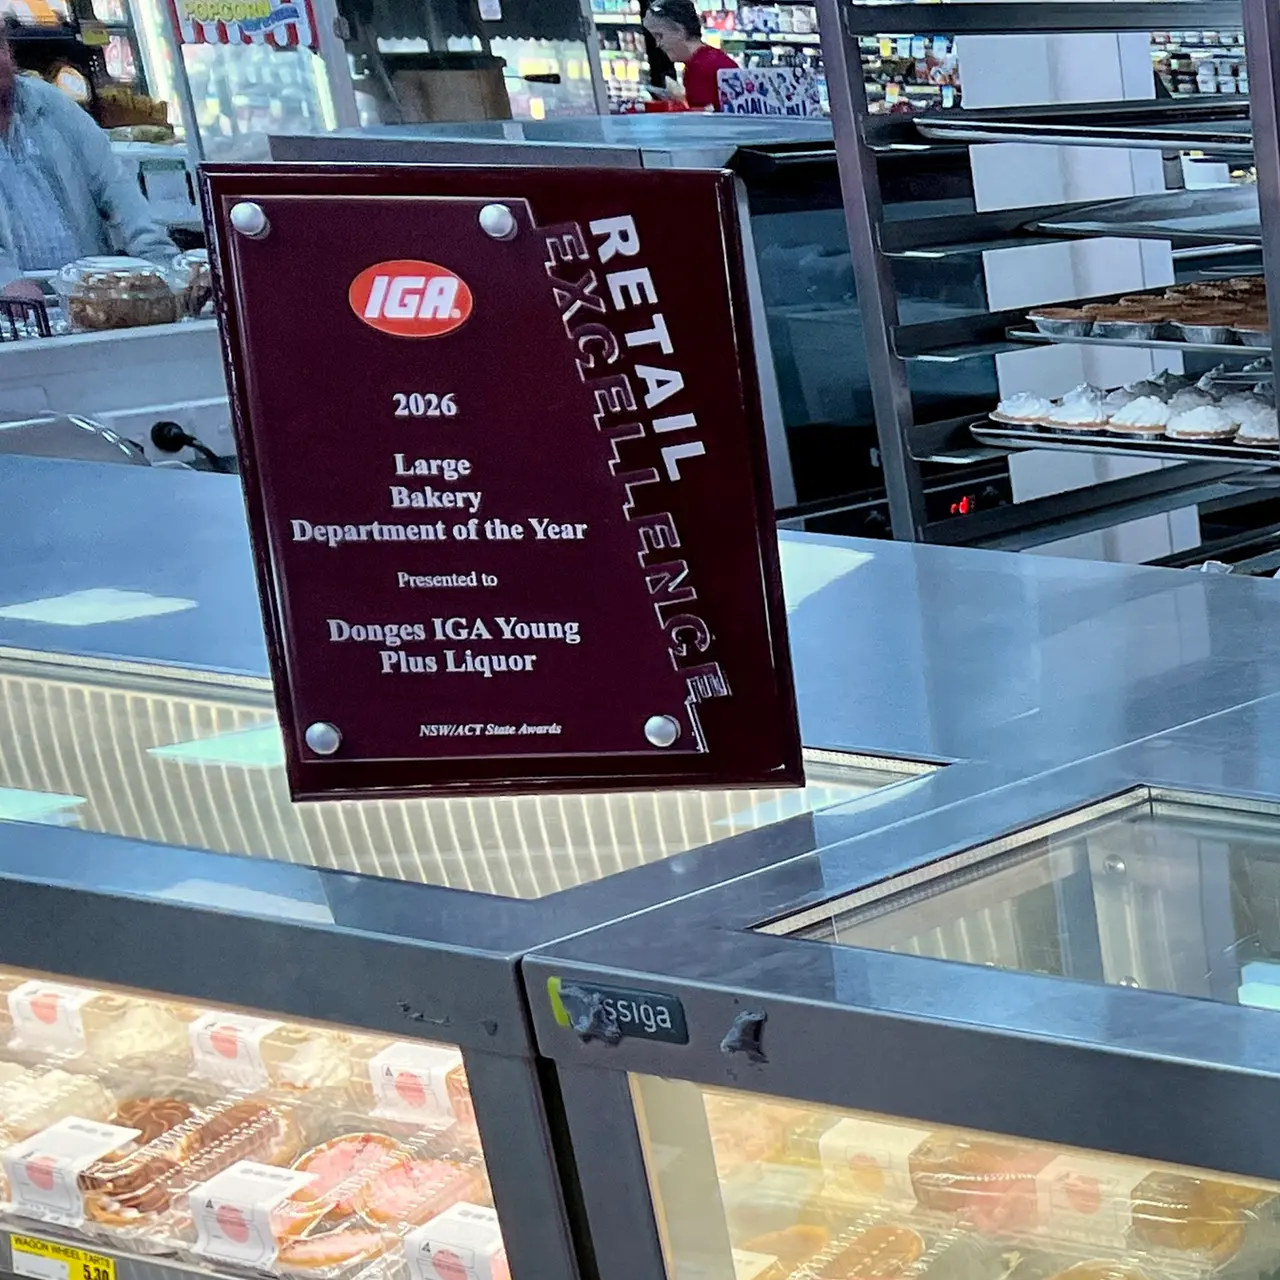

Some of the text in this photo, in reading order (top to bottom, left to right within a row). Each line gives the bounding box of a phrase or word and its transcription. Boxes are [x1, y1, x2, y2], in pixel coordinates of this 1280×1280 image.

[363, 276, 462, 319] IGA
[589, 214, 706, 482] RETAIL
[392, 392, 458, 418] 2026
[394, 452, 472, 480] Large
[545, 224, 733, 703] EXCELLENCE
[390, 485, 482, 515] Bakery
[291, 518, 588, 548] Department of the Year
[397, 570, 498, 588] Presented to
[327, 618, 581, 648] Donges IGA Young
[380, 650, 536, 678] Plus Liquor
[419, 721, 563, 737] NSW/ACT State Awards
[602, 998, 672, 1033] ssiga
[51, 1244, 81, 1260] WHEEL
